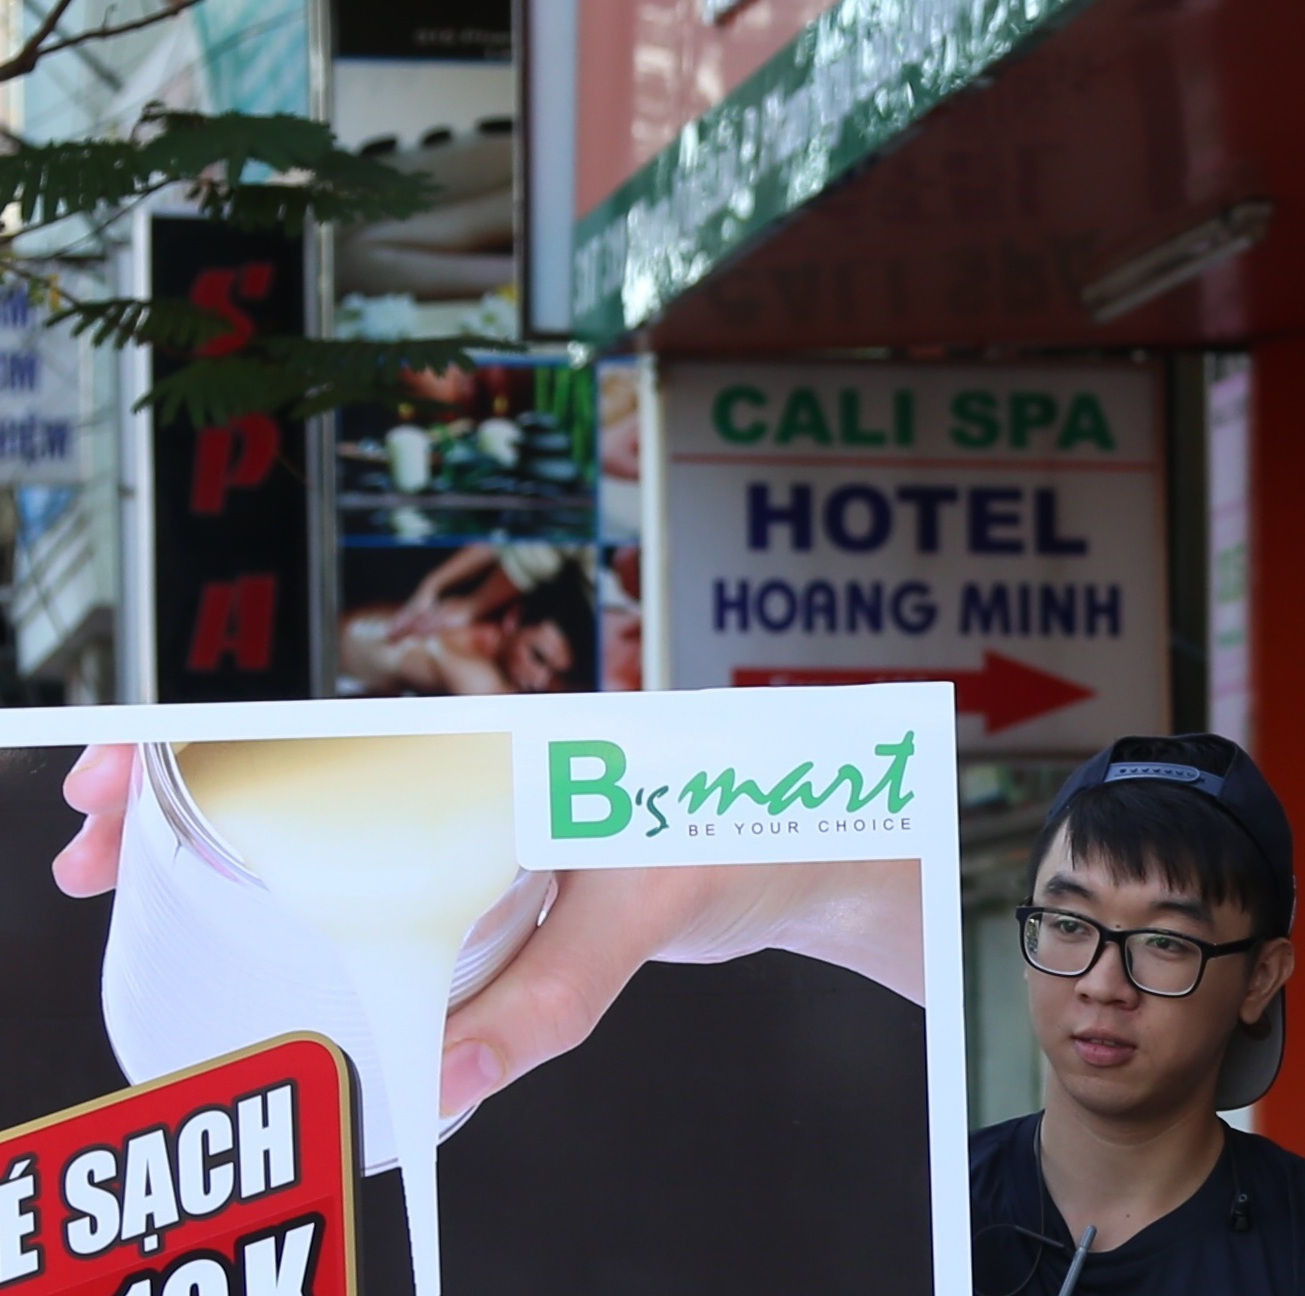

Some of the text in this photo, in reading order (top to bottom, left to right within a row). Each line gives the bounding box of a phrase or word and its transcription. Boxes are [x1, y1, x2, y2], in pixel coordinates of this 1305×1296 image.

[711, 384, 1117, 450] CALI SPA
[746, 481, 1089, 557] HOTEL
[712, 577, 1124, 638] HOANG MINH
[677, 730, 915, 816] mart
[688, 817, 913, 837] BE YOUR CHOICE
[63, 1084, 296, 1254] SẠCH
